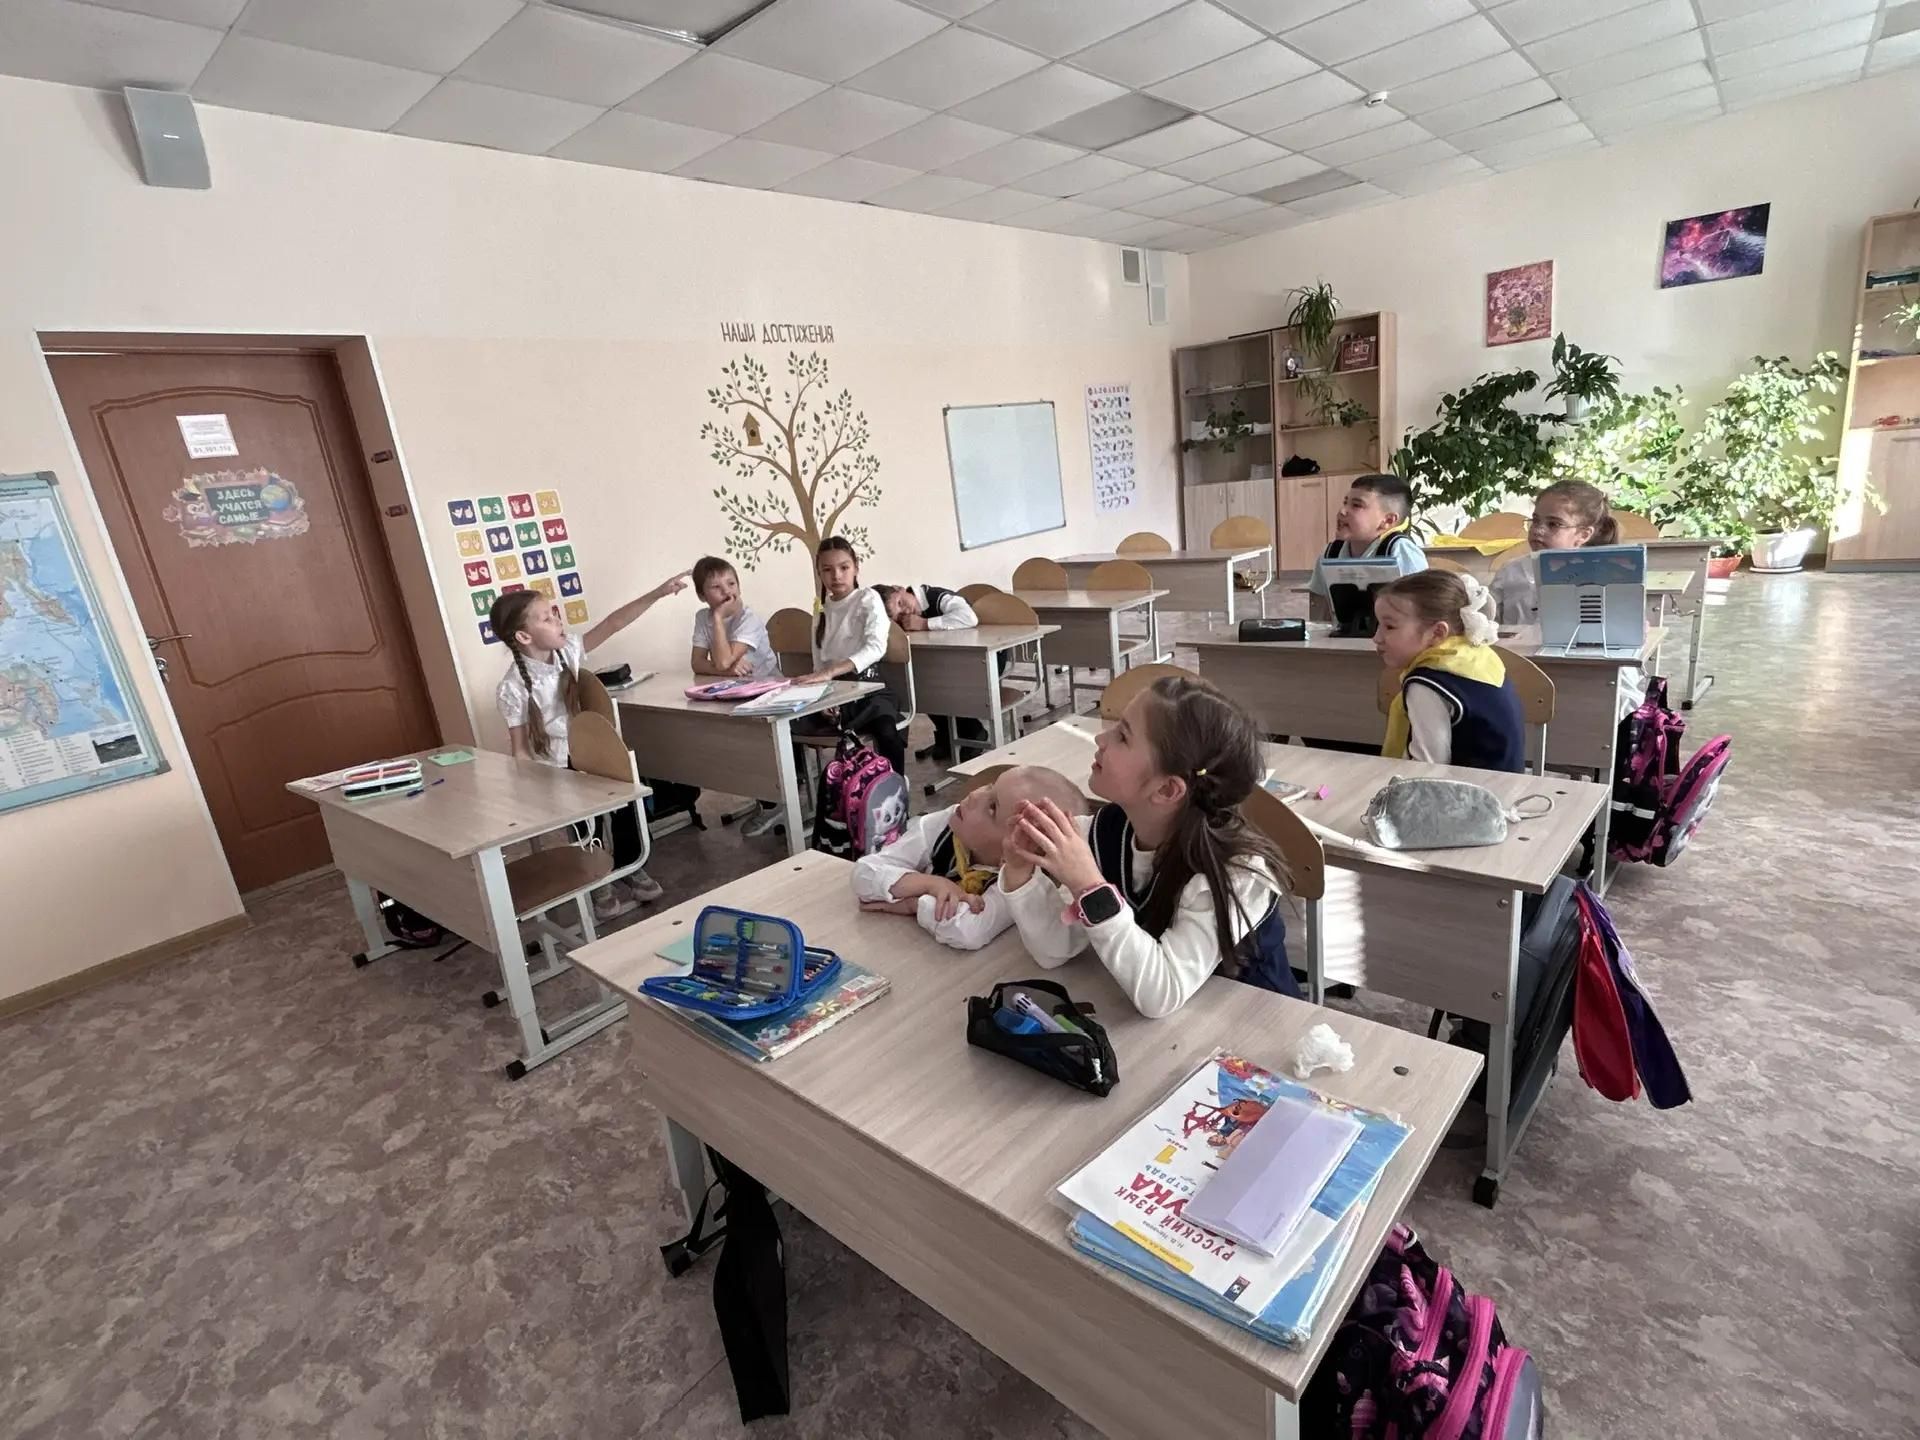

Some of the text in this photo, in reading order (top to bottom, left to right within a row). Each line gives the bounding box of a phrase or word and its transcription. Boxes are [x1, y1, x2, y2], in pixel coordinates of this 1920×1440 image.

[721, 322, 834, 344] НАШИ ДОСТИЖЕНИЯ
[217, 488, 255, 501] ЗДЕСЬ
[217, 500, 263, 513] УЧАТСЯ
[219, 511, 260, 524] САМЫЕ
[1154, 1144, 1178, 1164] 1
[1114, 1185, 1159, 1216] ЯЗЫК
[1160, 1214, 1236, 1261] РУССКИЙ
